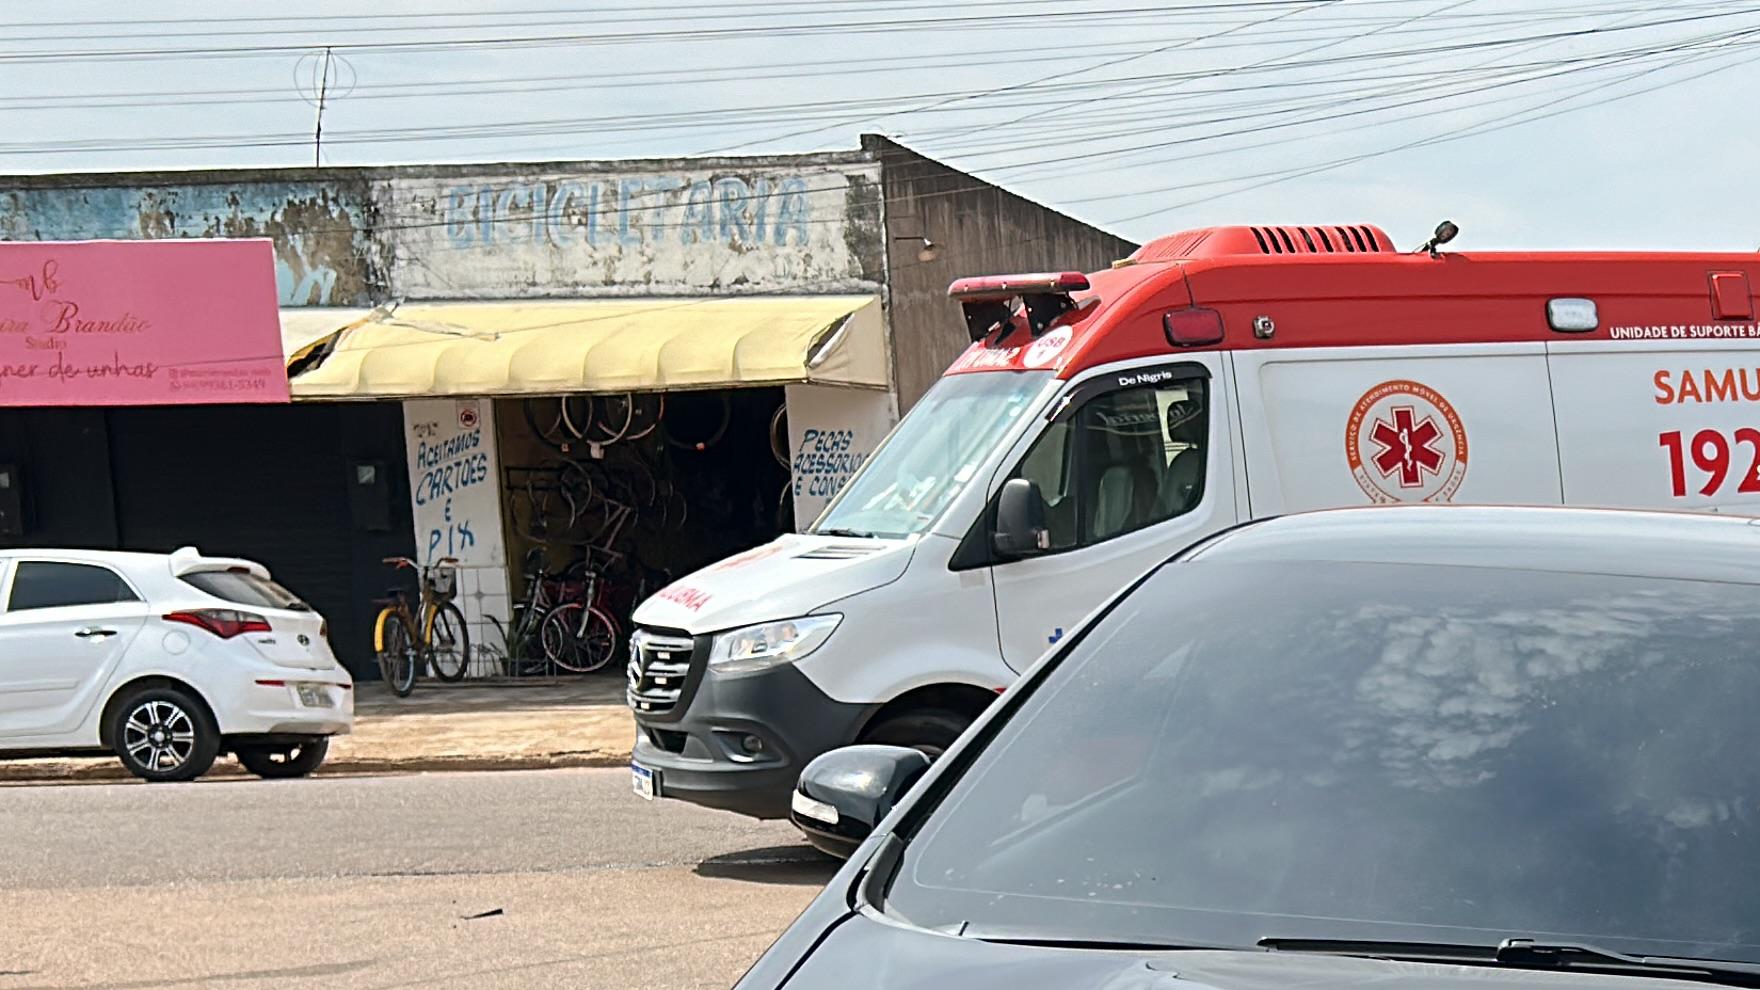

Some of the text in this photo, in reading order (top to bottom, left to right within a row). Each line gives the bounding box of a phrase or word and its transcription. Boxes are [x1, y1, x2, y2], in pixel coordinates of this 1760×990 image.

[445, 175, 810, 250] BICICLETARIA
[41, 300, 152, 334] Brandão
[1610, 325, 1668, 339] UNIDADE
[1671, 325, 1687, 338] DE
[1690, 324, 1745, 338] SUPORTE
[86, 352, 158, 379] unhas
[1118, 371, 1173, 386] De Nigris
[417, 428, 480, 470] ACEITAMOS
[794, 475, 852, 496] E CONS
[444, 499, 451, 522] E
[427, 520, 475, 566] PIX
